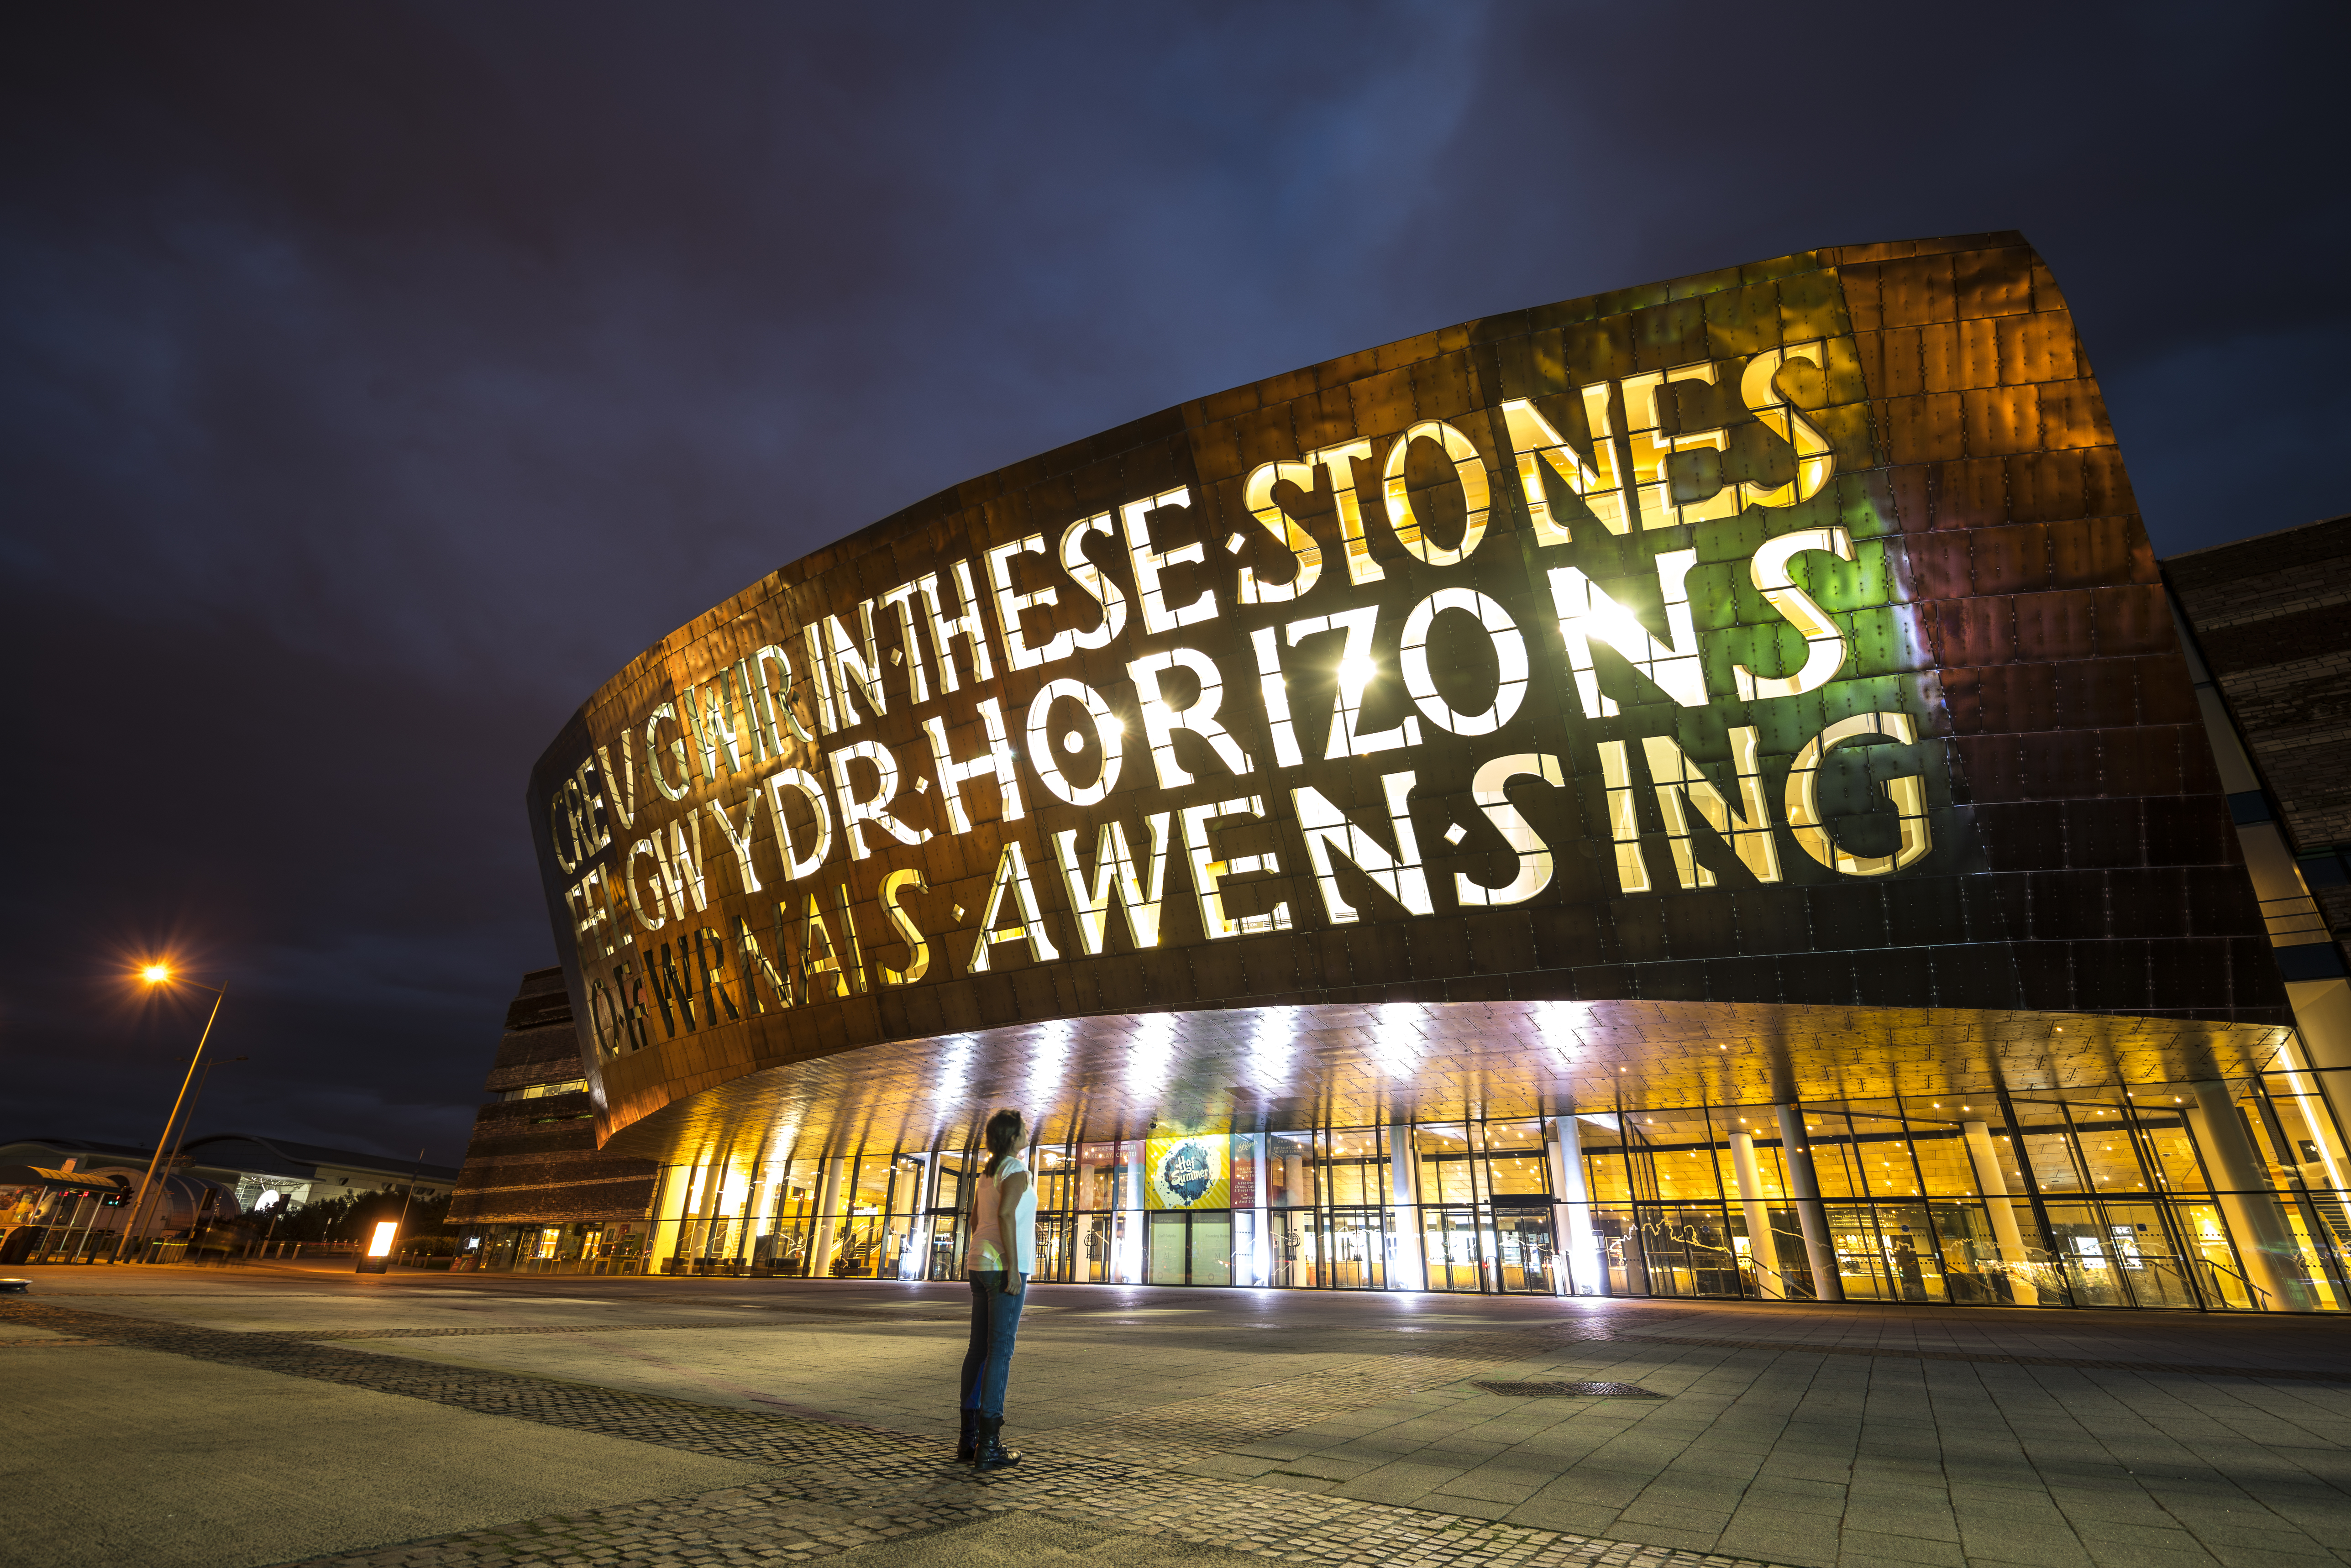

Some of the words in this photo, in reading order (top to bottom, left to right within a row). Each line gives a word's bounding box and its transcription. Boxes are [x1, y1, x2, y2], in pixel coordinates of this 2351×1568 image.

[646, 644, 813, 801] GWIR
[803, 598, 887, 736] IN
[879, 485, 1218, 704] THESE
[1238, 336, 1837, 604] STONES
[922, 526, 1859, 835] HORIZONS
[967, 770, 1434, 974] AWEN
[1454, 712, 1932, 907] SING
[1171, 1168, 1208, 1186] Summer
[1175, 1156, 1195, 1173] Haf
